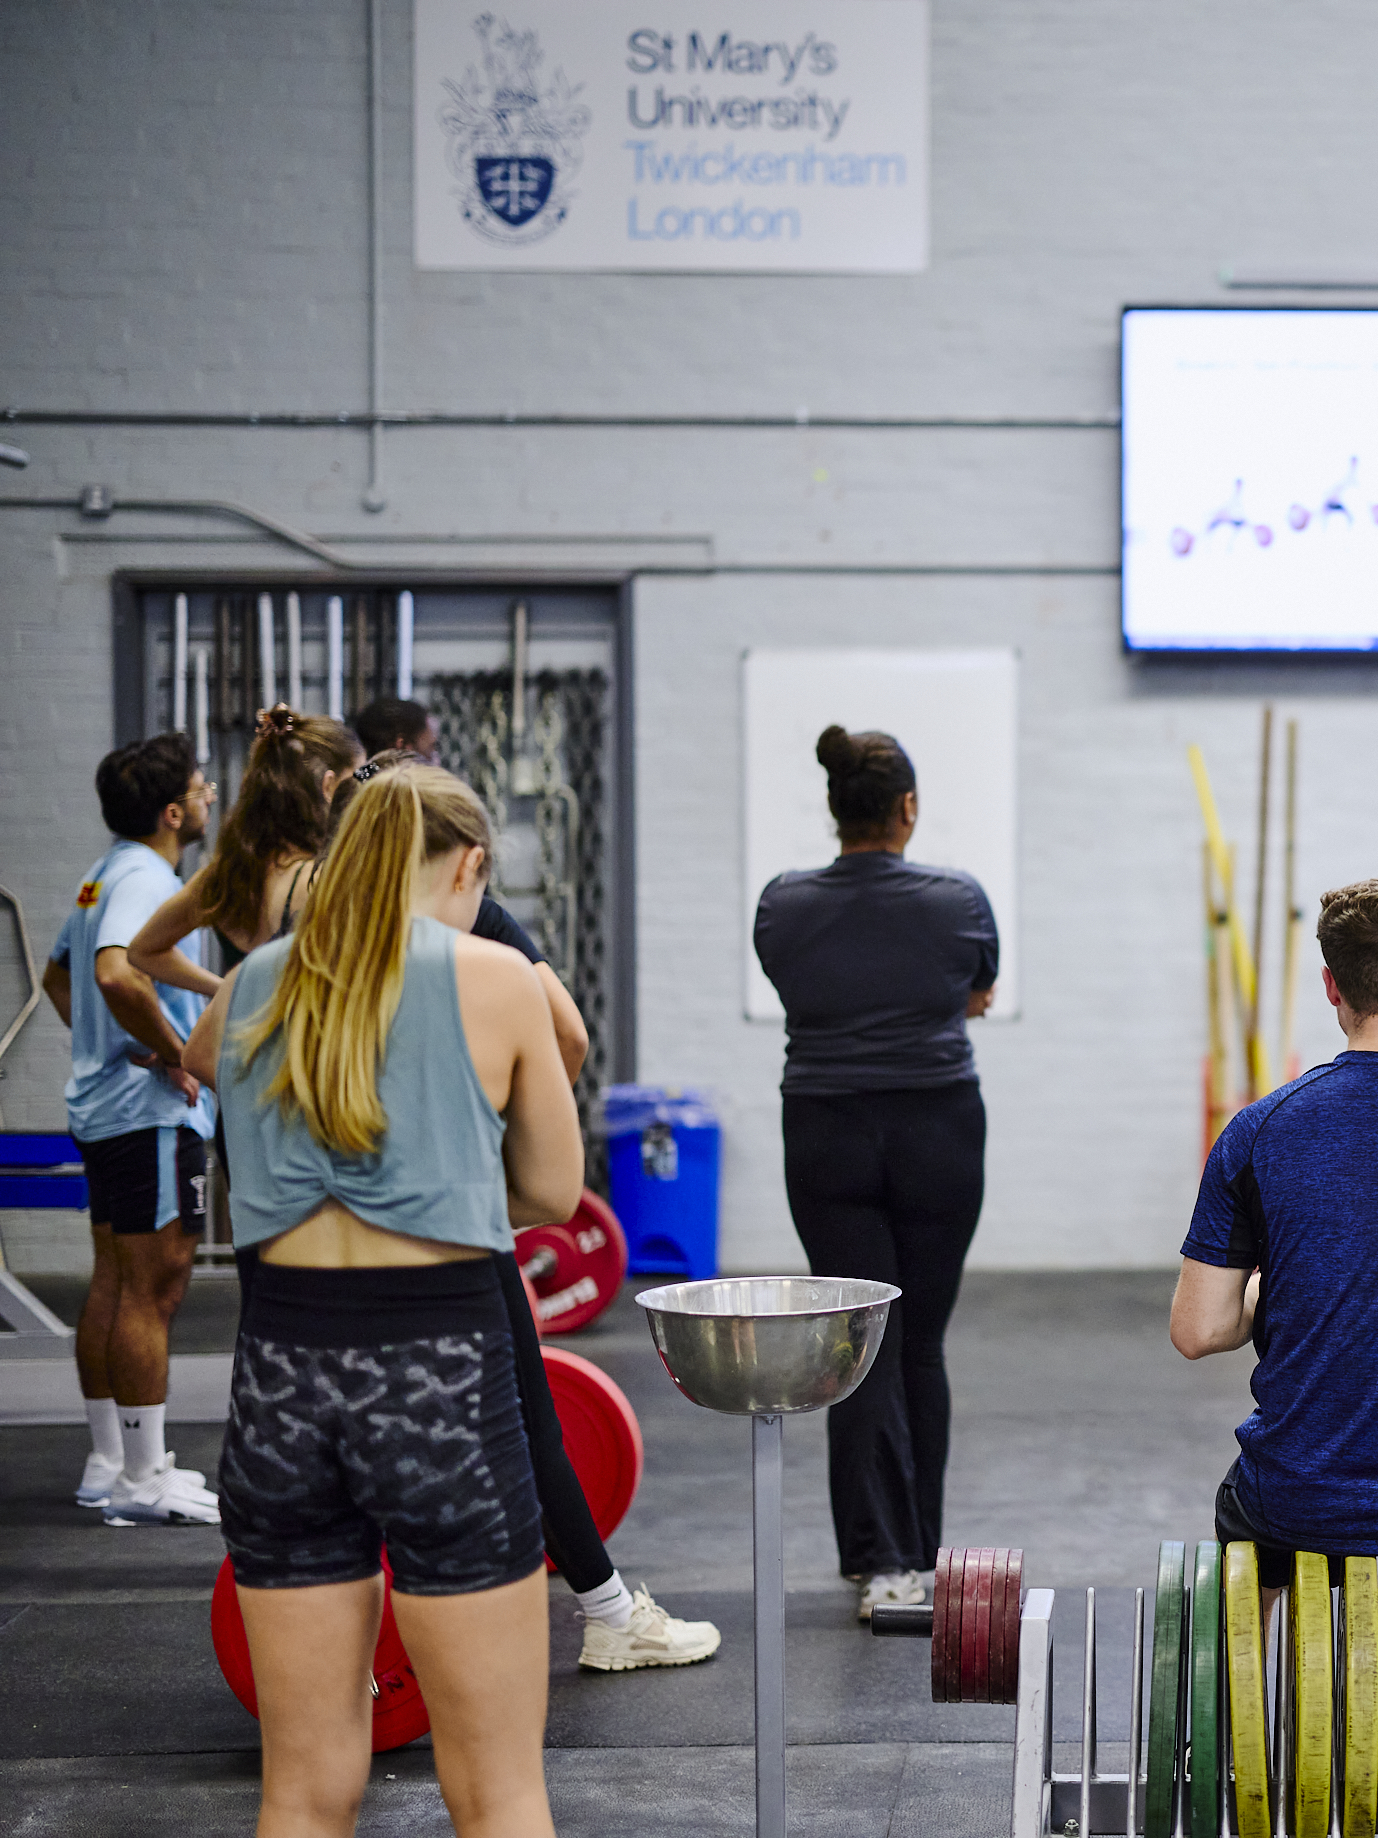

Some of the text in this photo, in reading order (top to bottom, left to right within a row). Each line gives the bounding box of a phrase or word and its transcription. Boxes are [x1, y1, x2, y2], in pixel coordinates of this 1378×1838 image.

[626, 28, 839, 85] St Mary's
[626, 86, 850, 141] University
[624, 141, 907, 187] Twickenham
[627, 199, 801, 242] London
